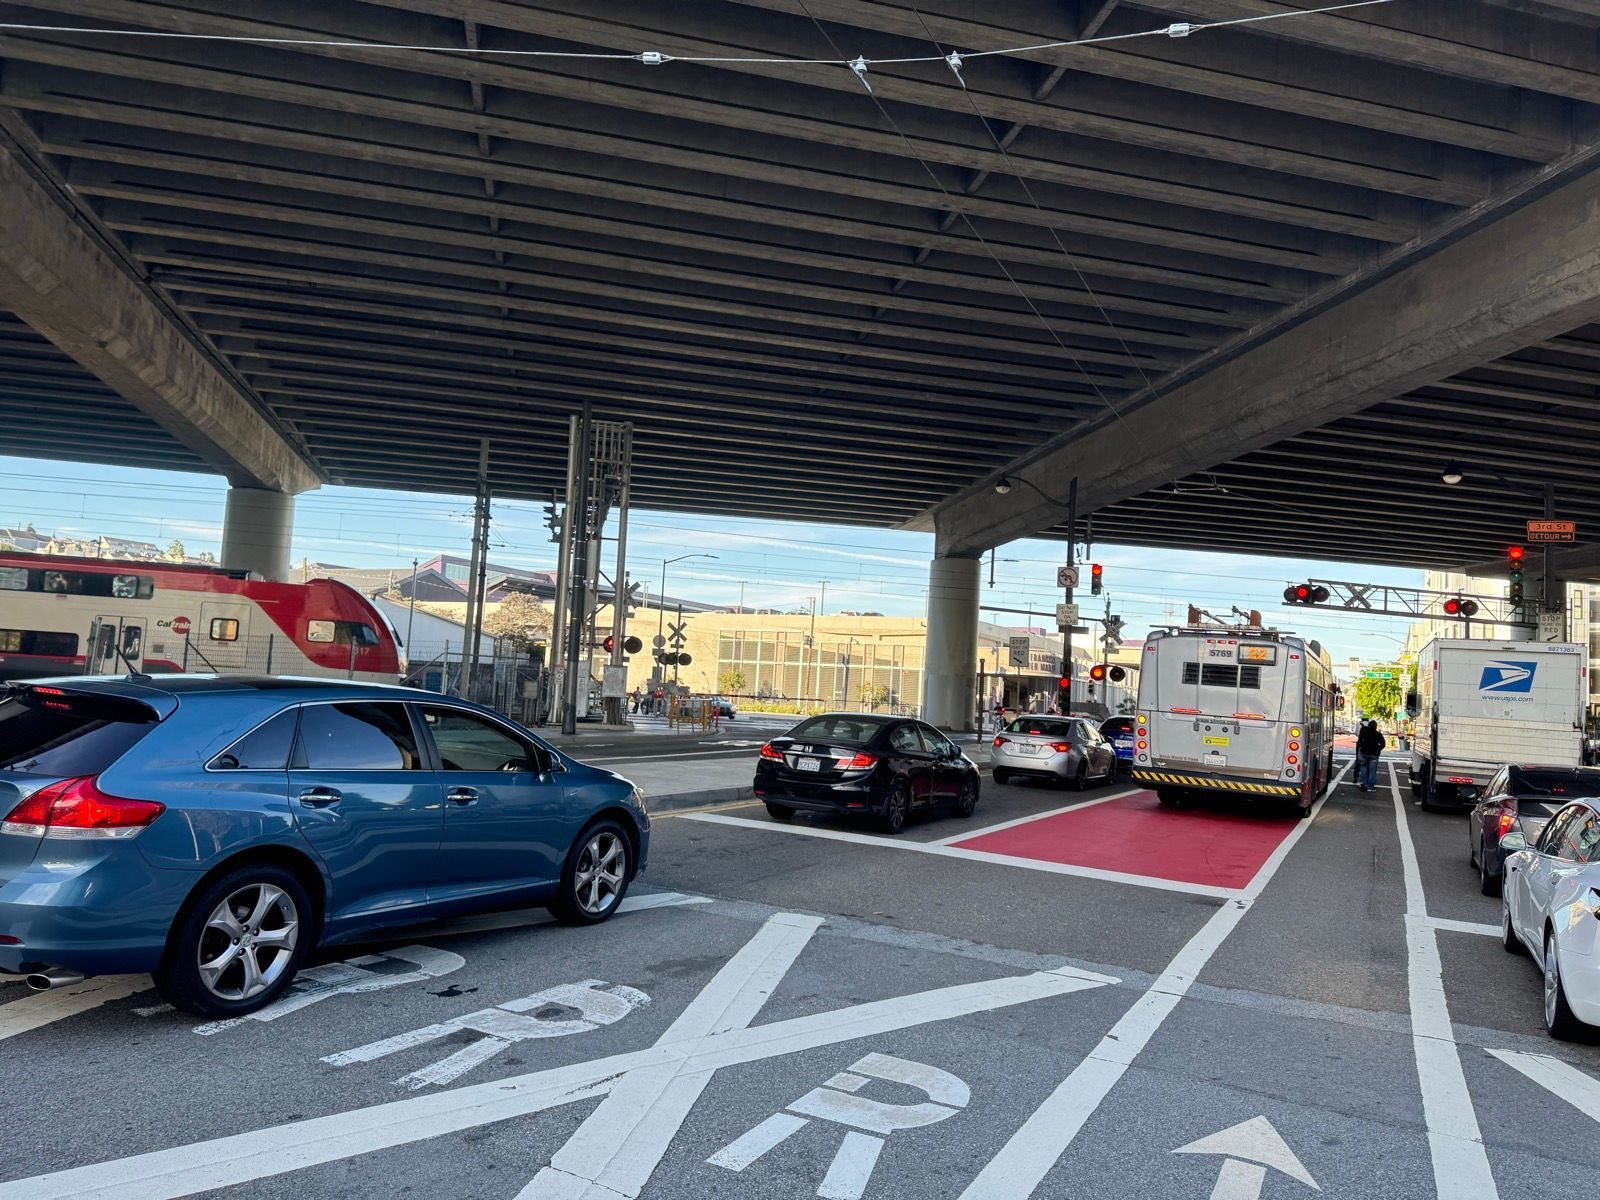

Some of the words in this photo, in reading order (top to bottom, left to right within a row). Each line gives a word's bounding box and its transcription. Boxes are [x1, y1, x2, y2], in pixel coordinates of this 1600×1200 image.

[156, 619, 191, 629] Caltrain
[1209, 649, 1232, 657] 5769
[1247, 646, 1266, 660] 22
[1481, 695, 1534, 703] www.usps.com
[705, 1051, 971, 1200] R
